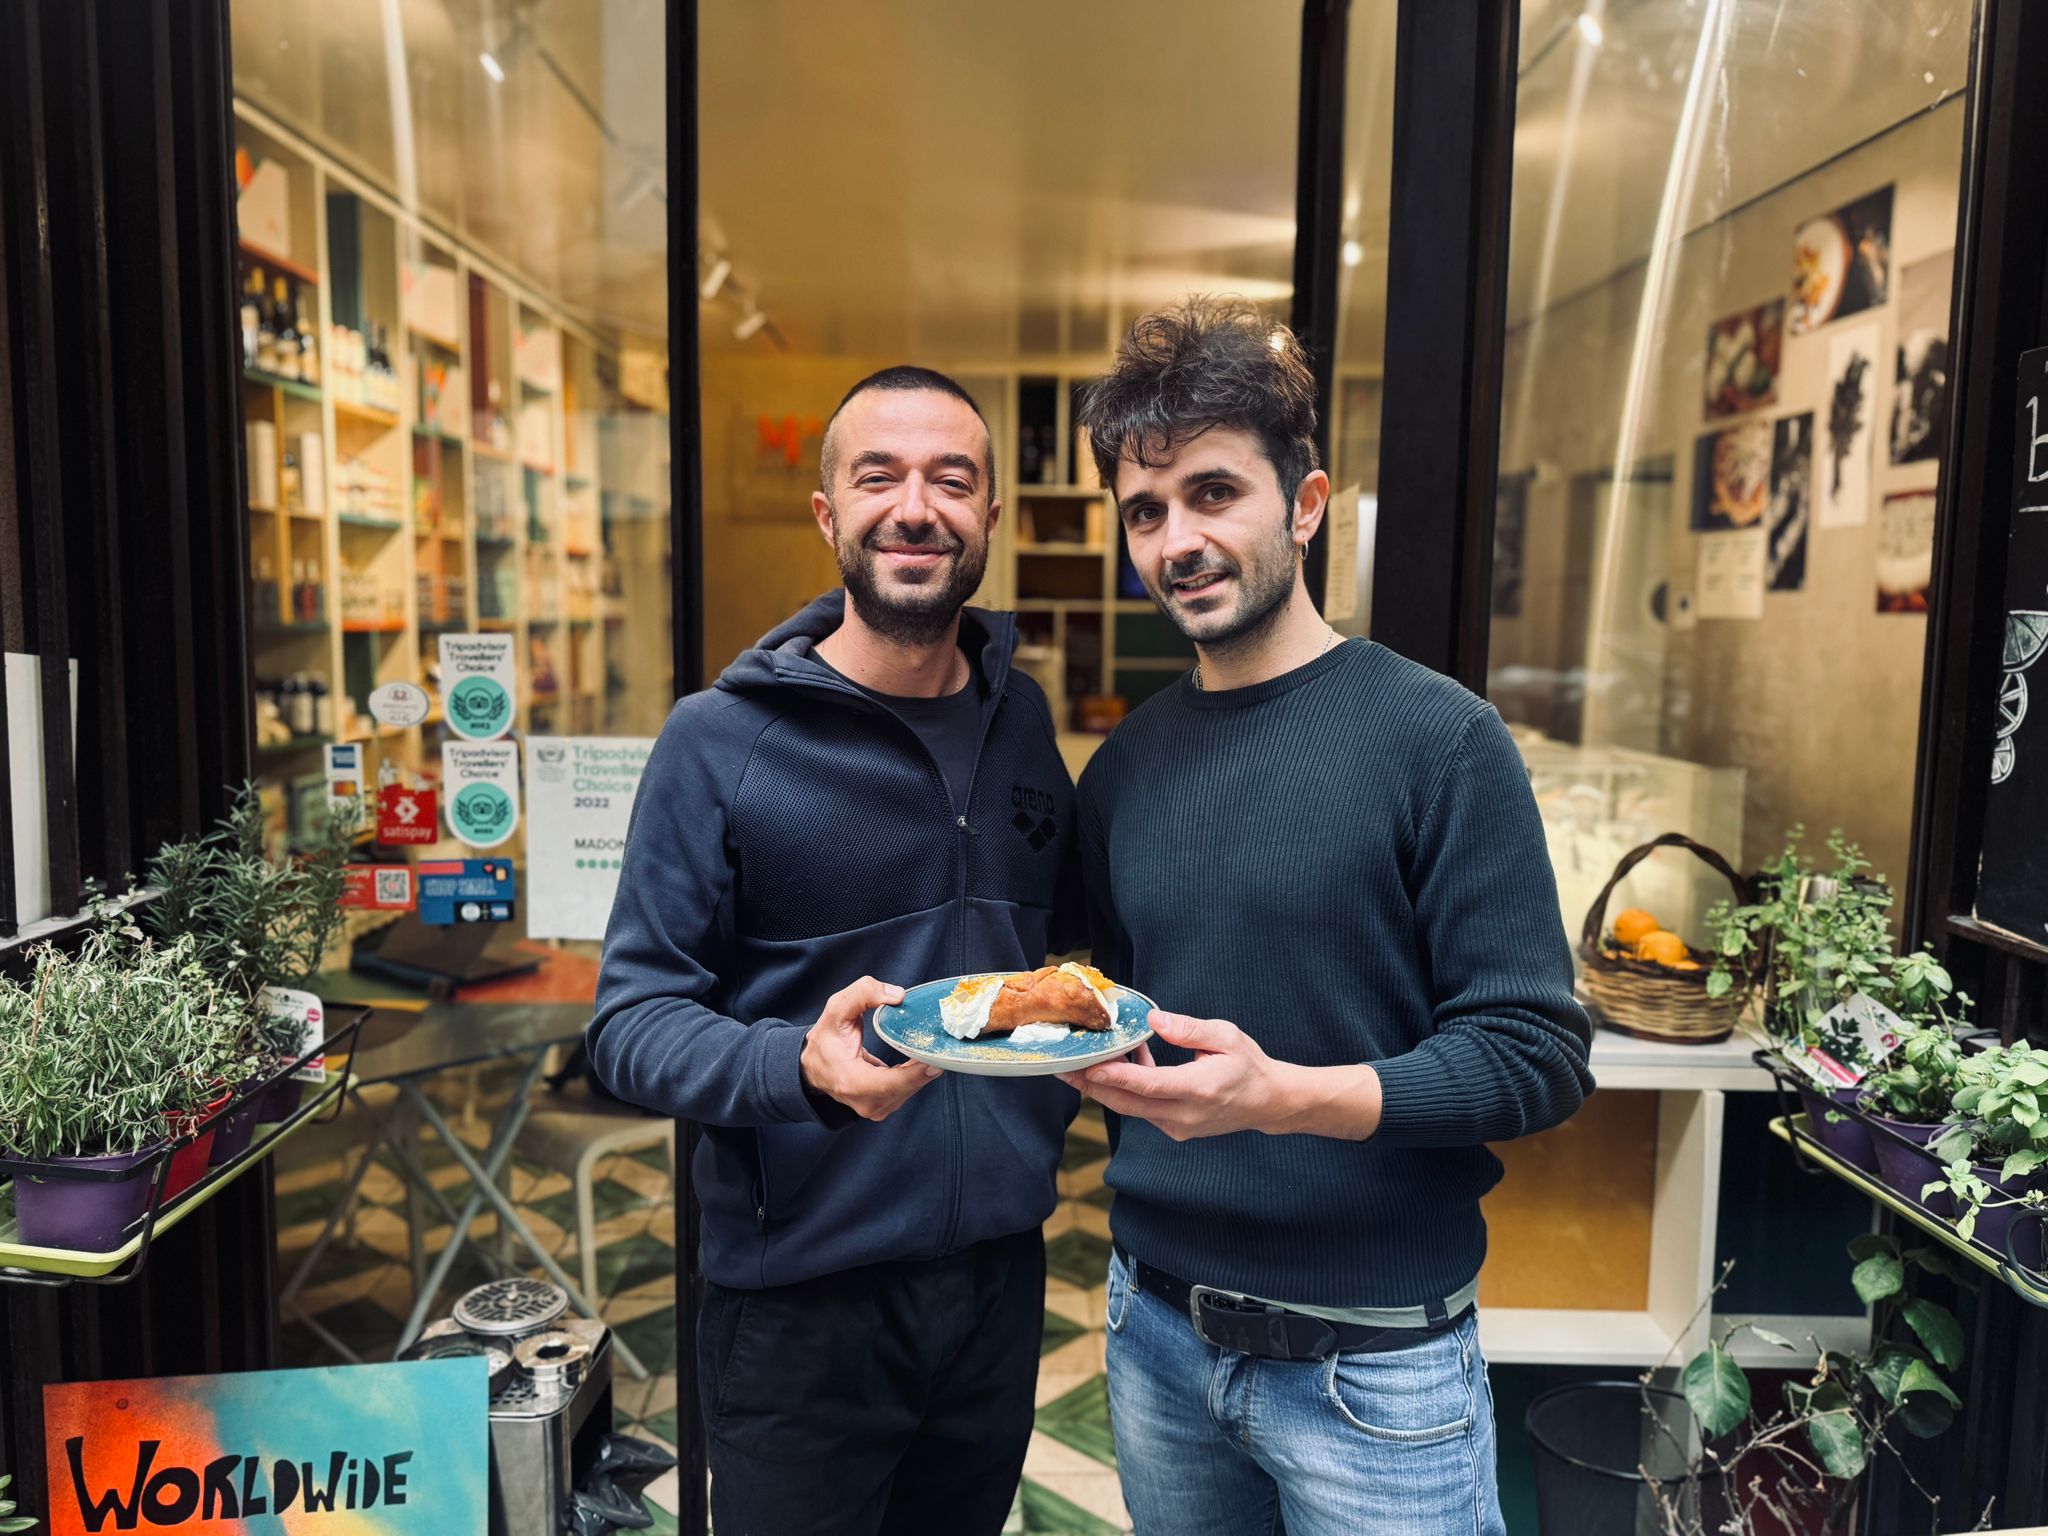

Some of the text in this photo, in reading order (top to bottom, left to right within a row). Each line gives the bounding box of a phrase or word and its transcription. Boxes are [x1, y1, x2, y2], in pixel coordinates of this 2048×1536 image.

[445, 641, 507, 652] Tripadvisor
[449, 652, 505, 661] Travellers'
[456, 663, 496, 672] Choice
[449, 748, 510, 758] Tripadvisor
[460, 769, 499, 778] Choice
[573, 778, 633, 793] Choice
[574, 796, 610, 808] 2022
[383, 827, 432, 841] satispay
